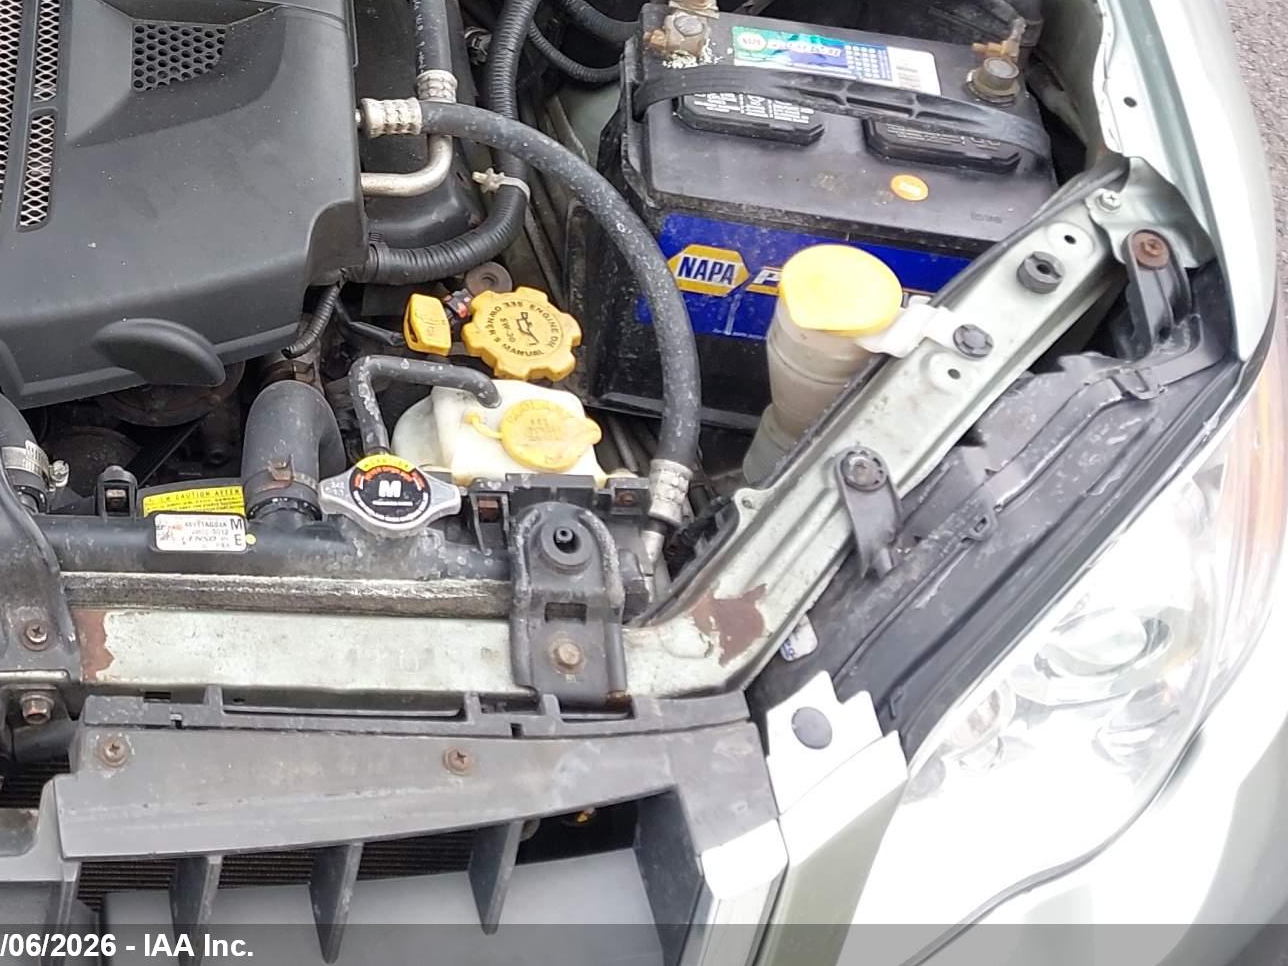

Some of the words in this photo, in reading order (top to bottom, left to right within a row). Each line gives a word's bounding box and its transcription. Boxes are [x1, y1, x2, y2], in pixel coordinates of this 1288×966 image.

[677, 255, 737, 286] NAPA
[529, 303, 560, 333] ENGINE
[378, 480, 402, 498] M
[230, 518, 243, 530] M
[234, 534, 243, 546] E
